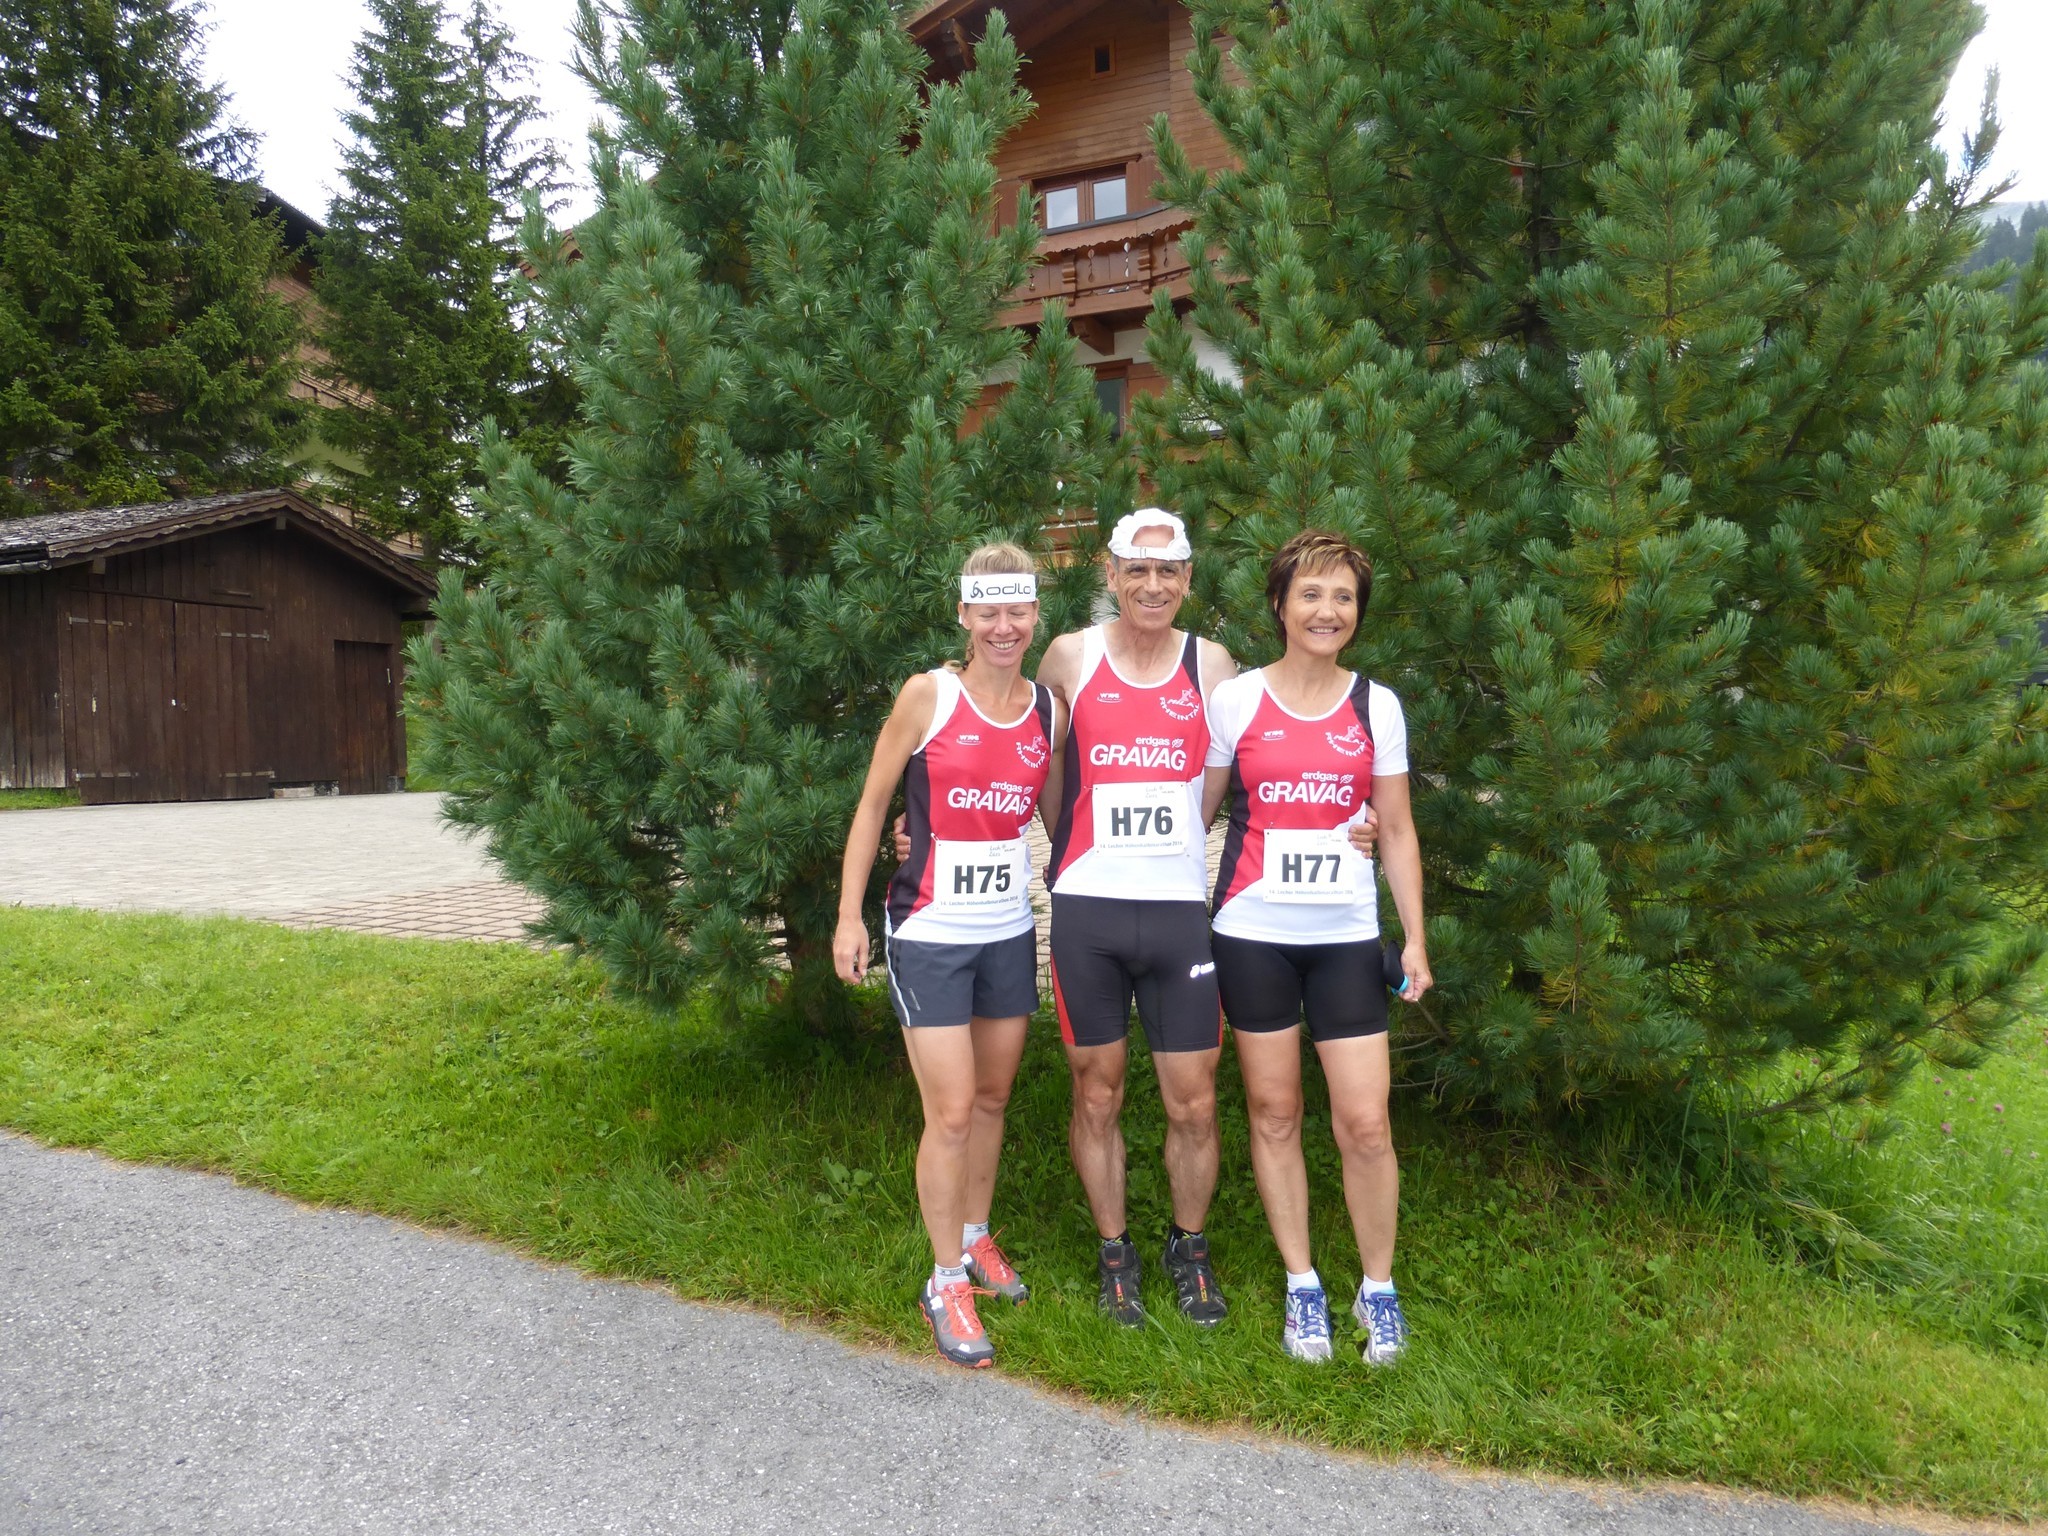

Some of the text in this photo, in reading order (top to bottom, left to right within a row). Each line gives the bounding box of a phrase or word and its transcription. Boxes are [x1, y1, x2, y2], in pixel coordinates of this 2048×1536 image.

[986, 582, 1032, 596] odlo
[1135, 736, 1171, 748] erdgas
[1089, 743, 1187, 772] GRAVAG
[990, 781, 1023, 793] erdgas
[1301, 770, 1339, 782] erdgas
[947, 786, 1032, 816] GRAVAG
[1257, 781, 1354, 807] GRAVAG
[1111, 805, 1173, 837] H76
[953, 863, 1011, 895] H75
[1281, 853, 1341, 883] H77
